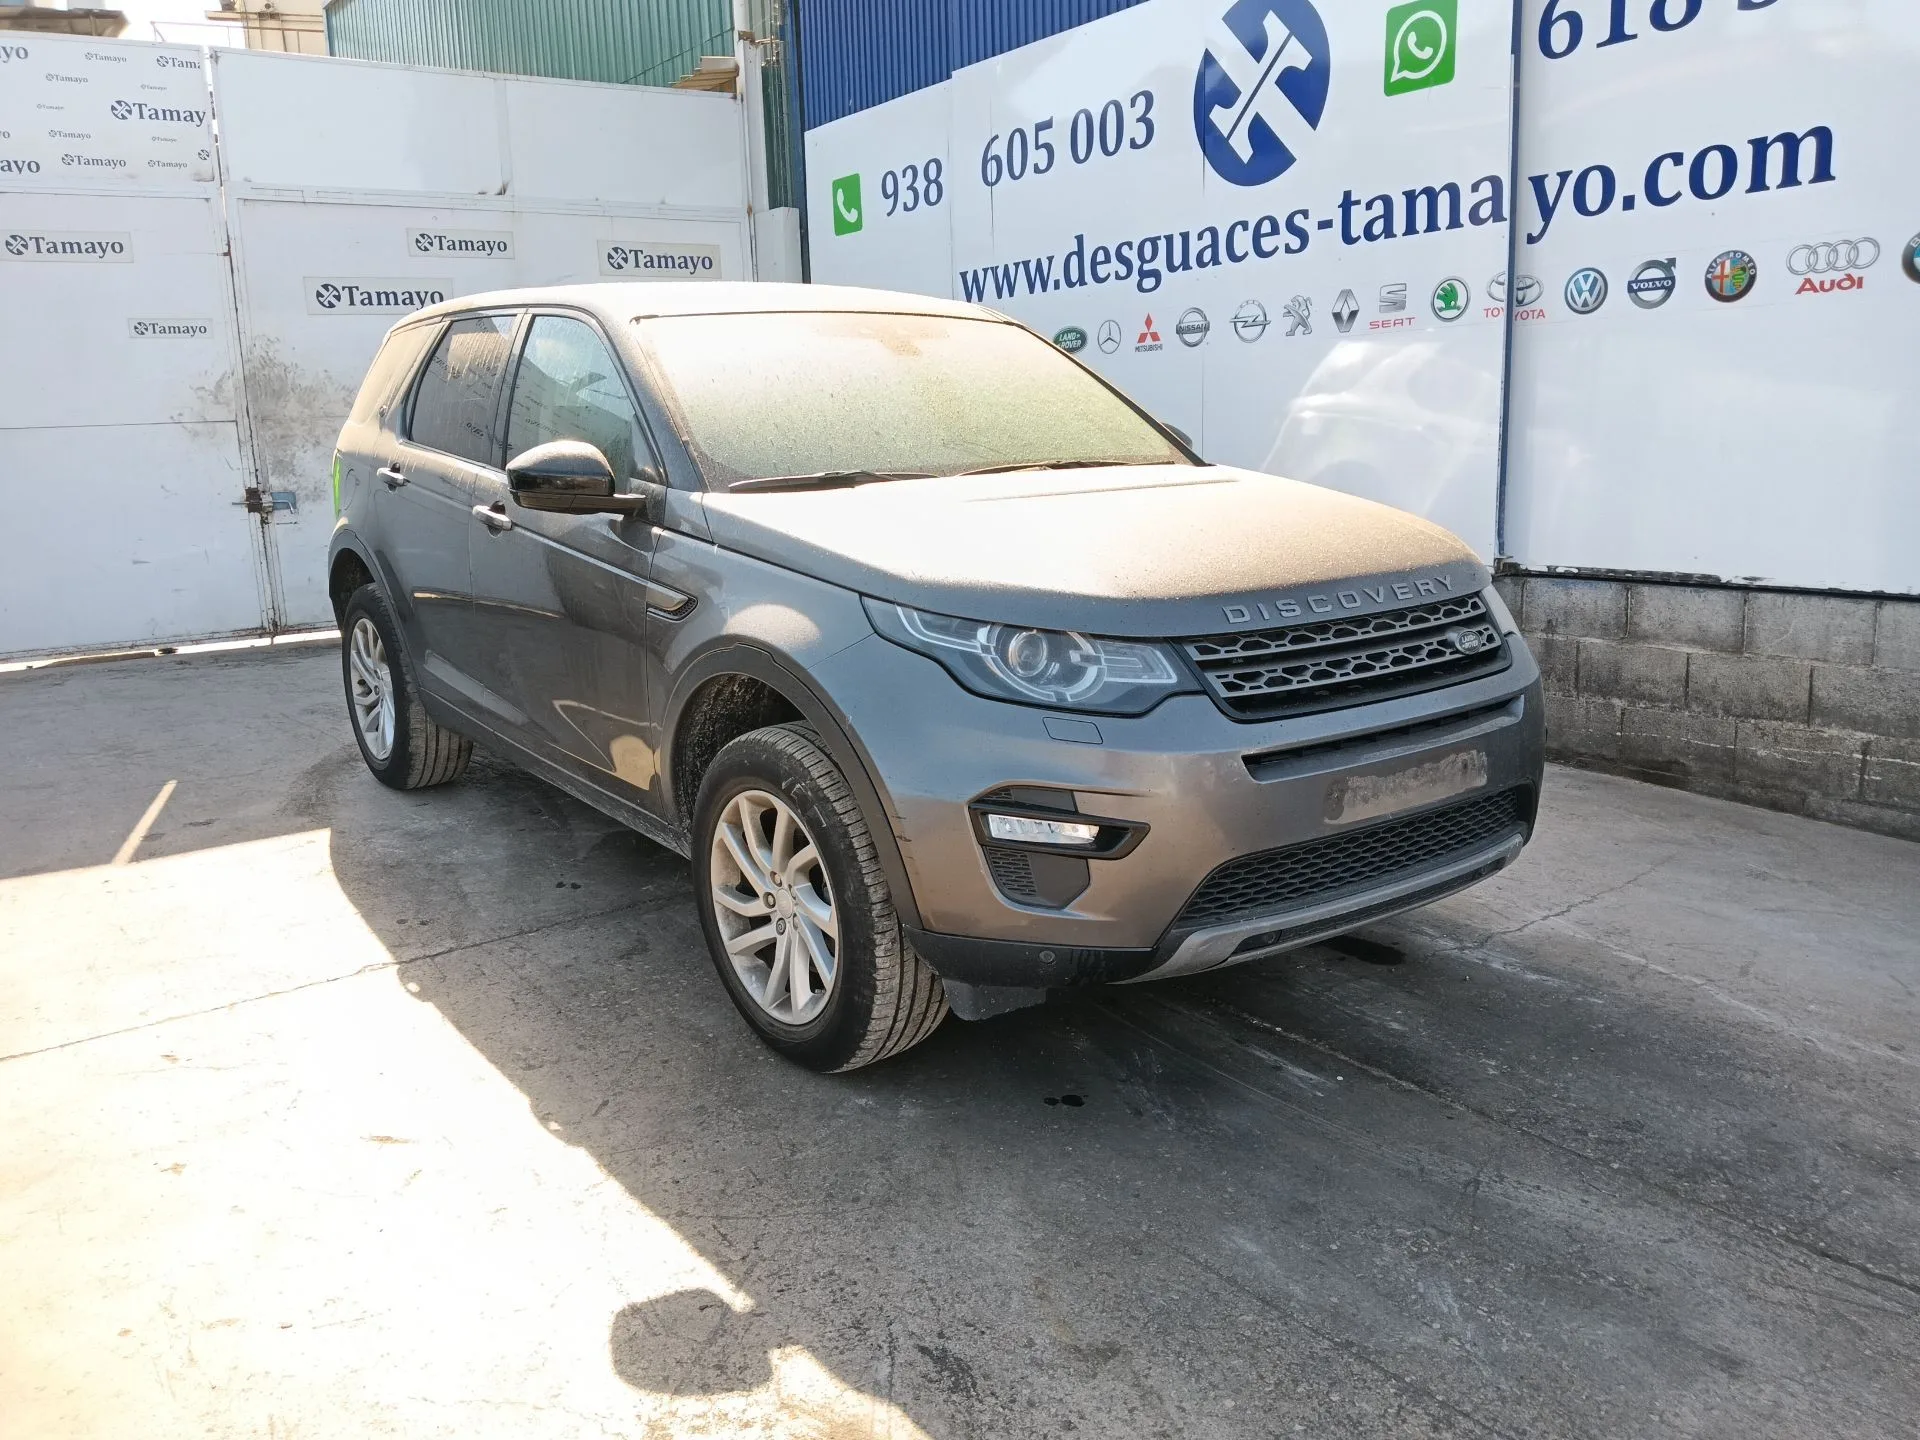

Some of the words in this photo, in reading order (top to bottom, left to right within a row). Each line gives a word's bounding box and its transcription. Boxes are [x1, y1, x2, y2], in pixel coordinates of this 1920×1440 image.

[93, 53, 127, 63] Tamayo
[54, 74, 88, 84] Tamayo
[57, 130, 91, 140] Tamayo
[881, 158, 943, 217] 938
[981, 116, 1055, 187] 605
[1070, 90, 1155, 165] 003
[74, 155, 127, 170] Tamayo
[156, 160, 188, 170] Tamayo
[29, 235, 124, 257] Tamayo
[433, 234, 508, 256] Tamayo
[628, 248, 715, 275] Tamayo
[1631, 279, 1673, 291] VOLVO
[1795, 273, 1864, 295] Audi
[341, 283, 445, 310] Tamayo
[148, 321, 208, 339] Tamayo
[1179, 322, 1207, 333] NISSAN
[1369, 316, 1415, 330] SEAT
[1059, 331, 1077, 340] LAND
[1134, 344, 1163, 353] MITSUBISHI
[1221, 574, 1455, 625] DISCOVERY
